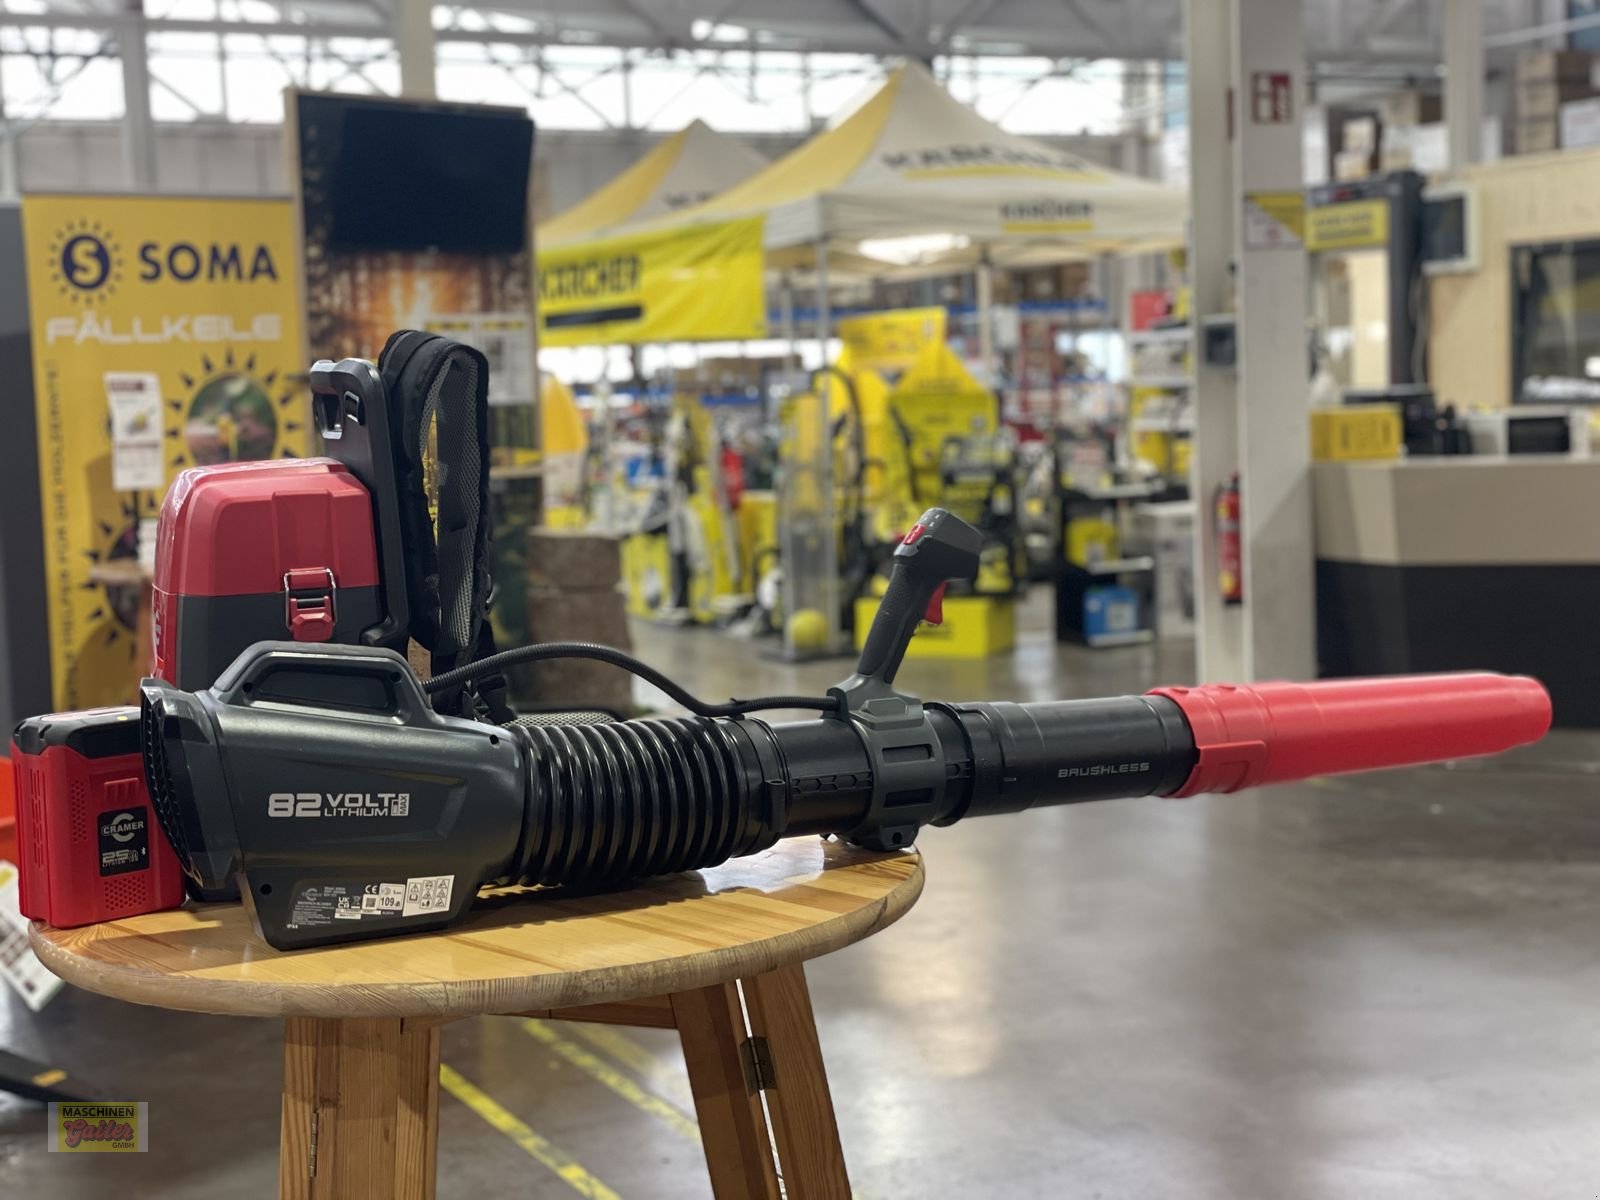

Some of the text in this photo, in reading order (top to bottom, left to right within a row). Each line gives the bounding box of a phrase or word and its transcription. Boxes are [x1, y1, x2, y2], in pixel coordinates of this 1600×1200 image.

[138, 243, 278, 281] SOMA
[1057, 763, 1150, 778] BRUSHLESS
[268, 793, 322, 817] 82
[326, 793, 396, 807] VOLT
[324, 808, 388, 817] LITHIUM
[103, 821, 144, 834] CRAMER
[365, 885, 377, 893] CE
[381, 897, 395, 906] 109
